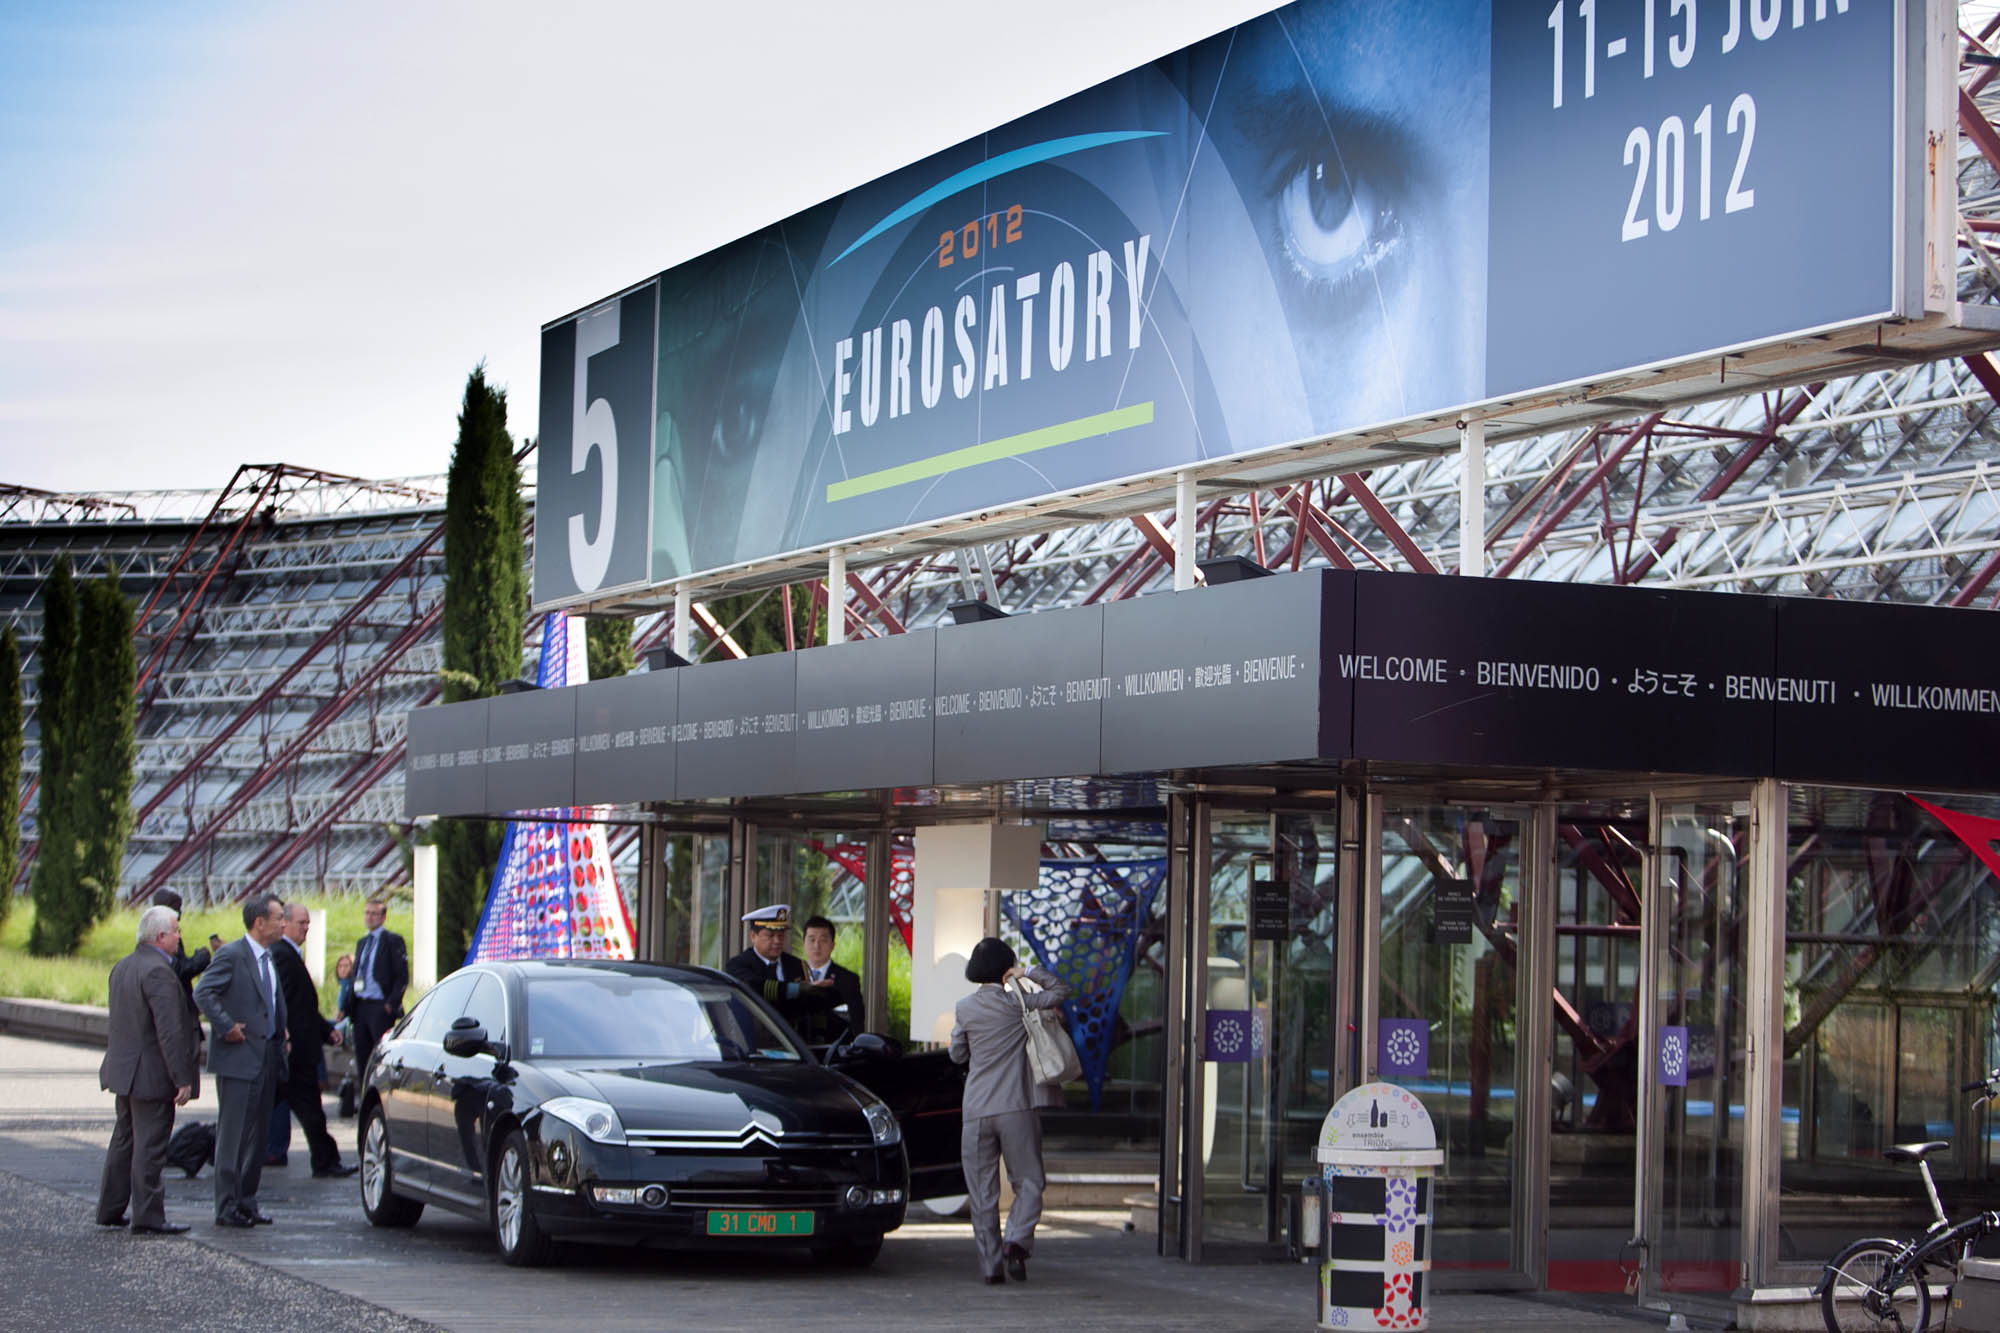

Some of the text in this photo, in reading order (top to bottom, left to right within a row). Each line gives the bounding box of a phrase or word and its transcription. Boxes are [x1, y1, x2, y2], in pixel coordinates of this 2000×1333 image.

[1547, 0, 1697, 109] 11-15
[1622, 93, 1756, 243] 2012
[938, 204, 1024, 268] 2012
[833, 234, 1151, 436] EUROSATORY
[568, 300, 621, 593] 5
[672, 723, 698, 742] WELCOME
[807, 707, 849, 730] WILLKOMMEN
[889, 698, 926, 721] BIENVENUE
[935, 693, 970, 716] WELCOME
[979, 688, 1022, 711] BIENVENIDO
[1030, 685, 1056, 707] ようこそ
[1066, 677, 1111, 703] BENVENUTI
[1125, 668, 1184, 696] WILLKOMMEN
[1243, 655, 1296, 683] BIENVENUE
[1339, 654, 2000, 712] WELCOME BIENVENIDO ようこそ BENVENUTI WILLKOMMEN
[720, 1214, 738, 1232] 31
[790, 1214, 796, 1232] 1
